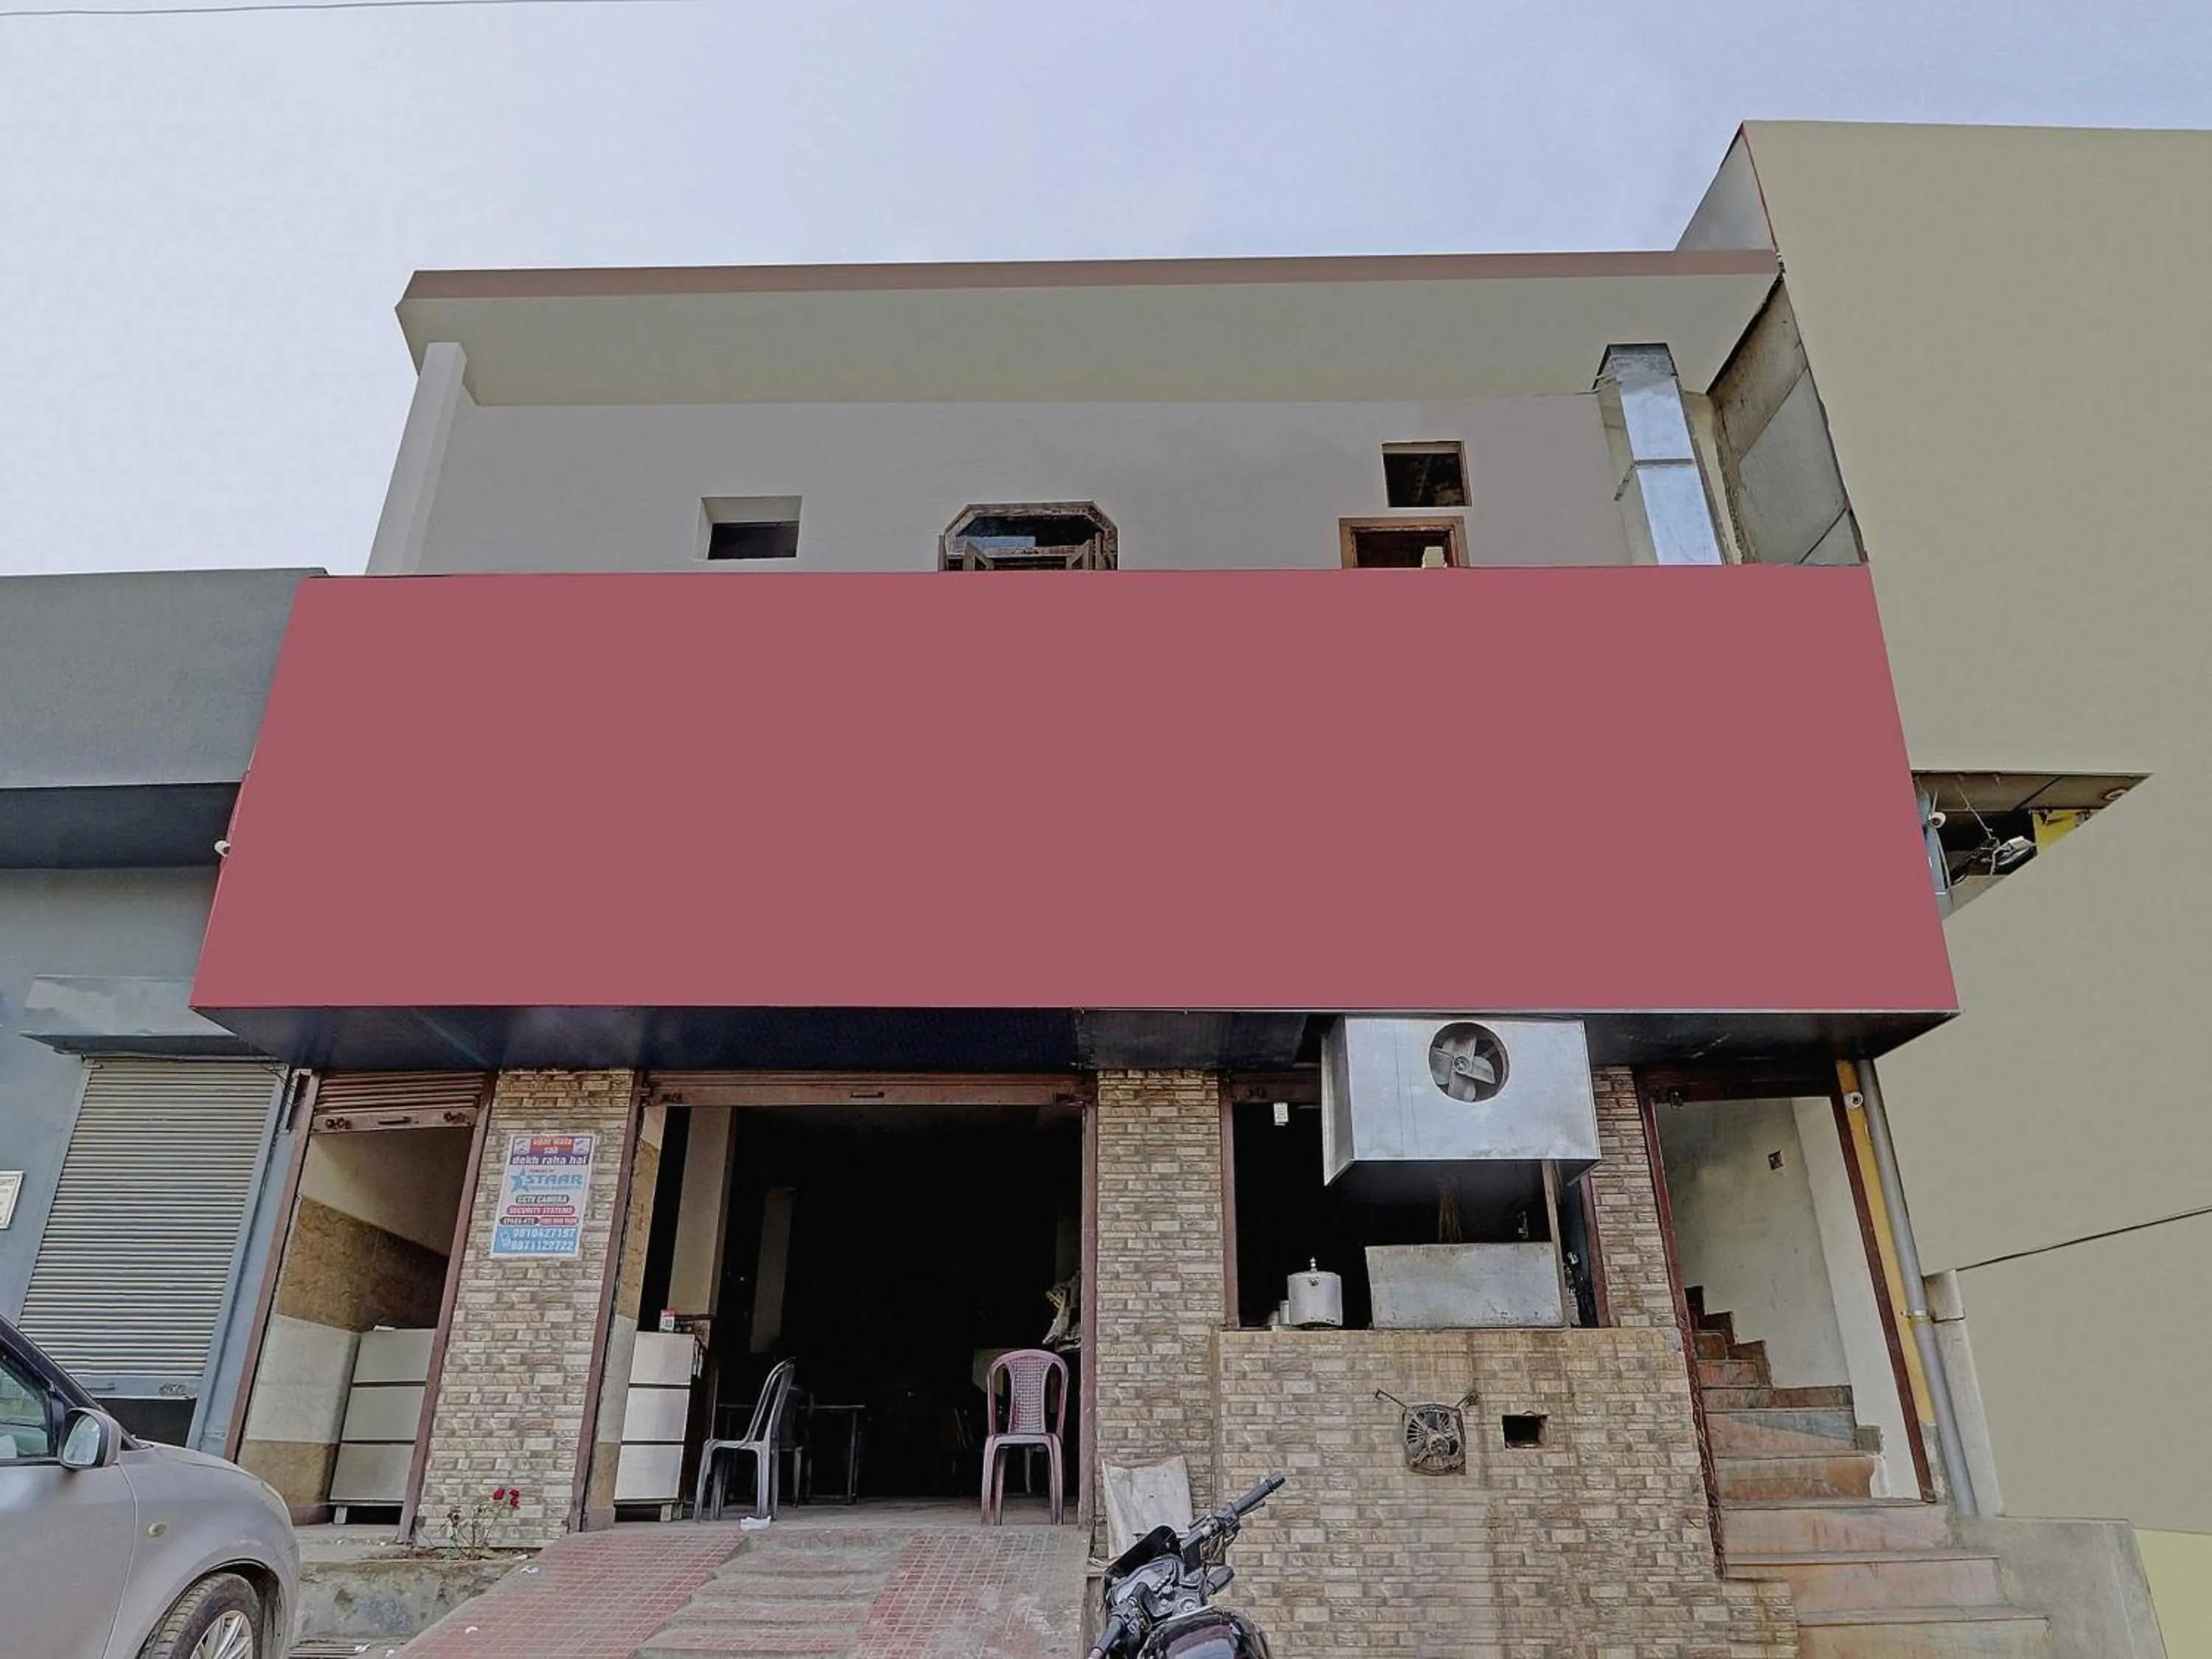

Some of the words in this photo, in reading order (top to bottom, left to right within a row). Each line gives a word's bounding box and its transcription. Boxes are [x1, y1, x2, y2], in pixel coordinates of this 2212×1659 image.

[512, 1156, 540, 1164] dekh
[542, 1156, 567, 1164] raha
[568, 1156, 588, 1164] hai
[526, 1175, 583, 1185] STAAR
[509, 1206, 541, 1214] SECURITY
